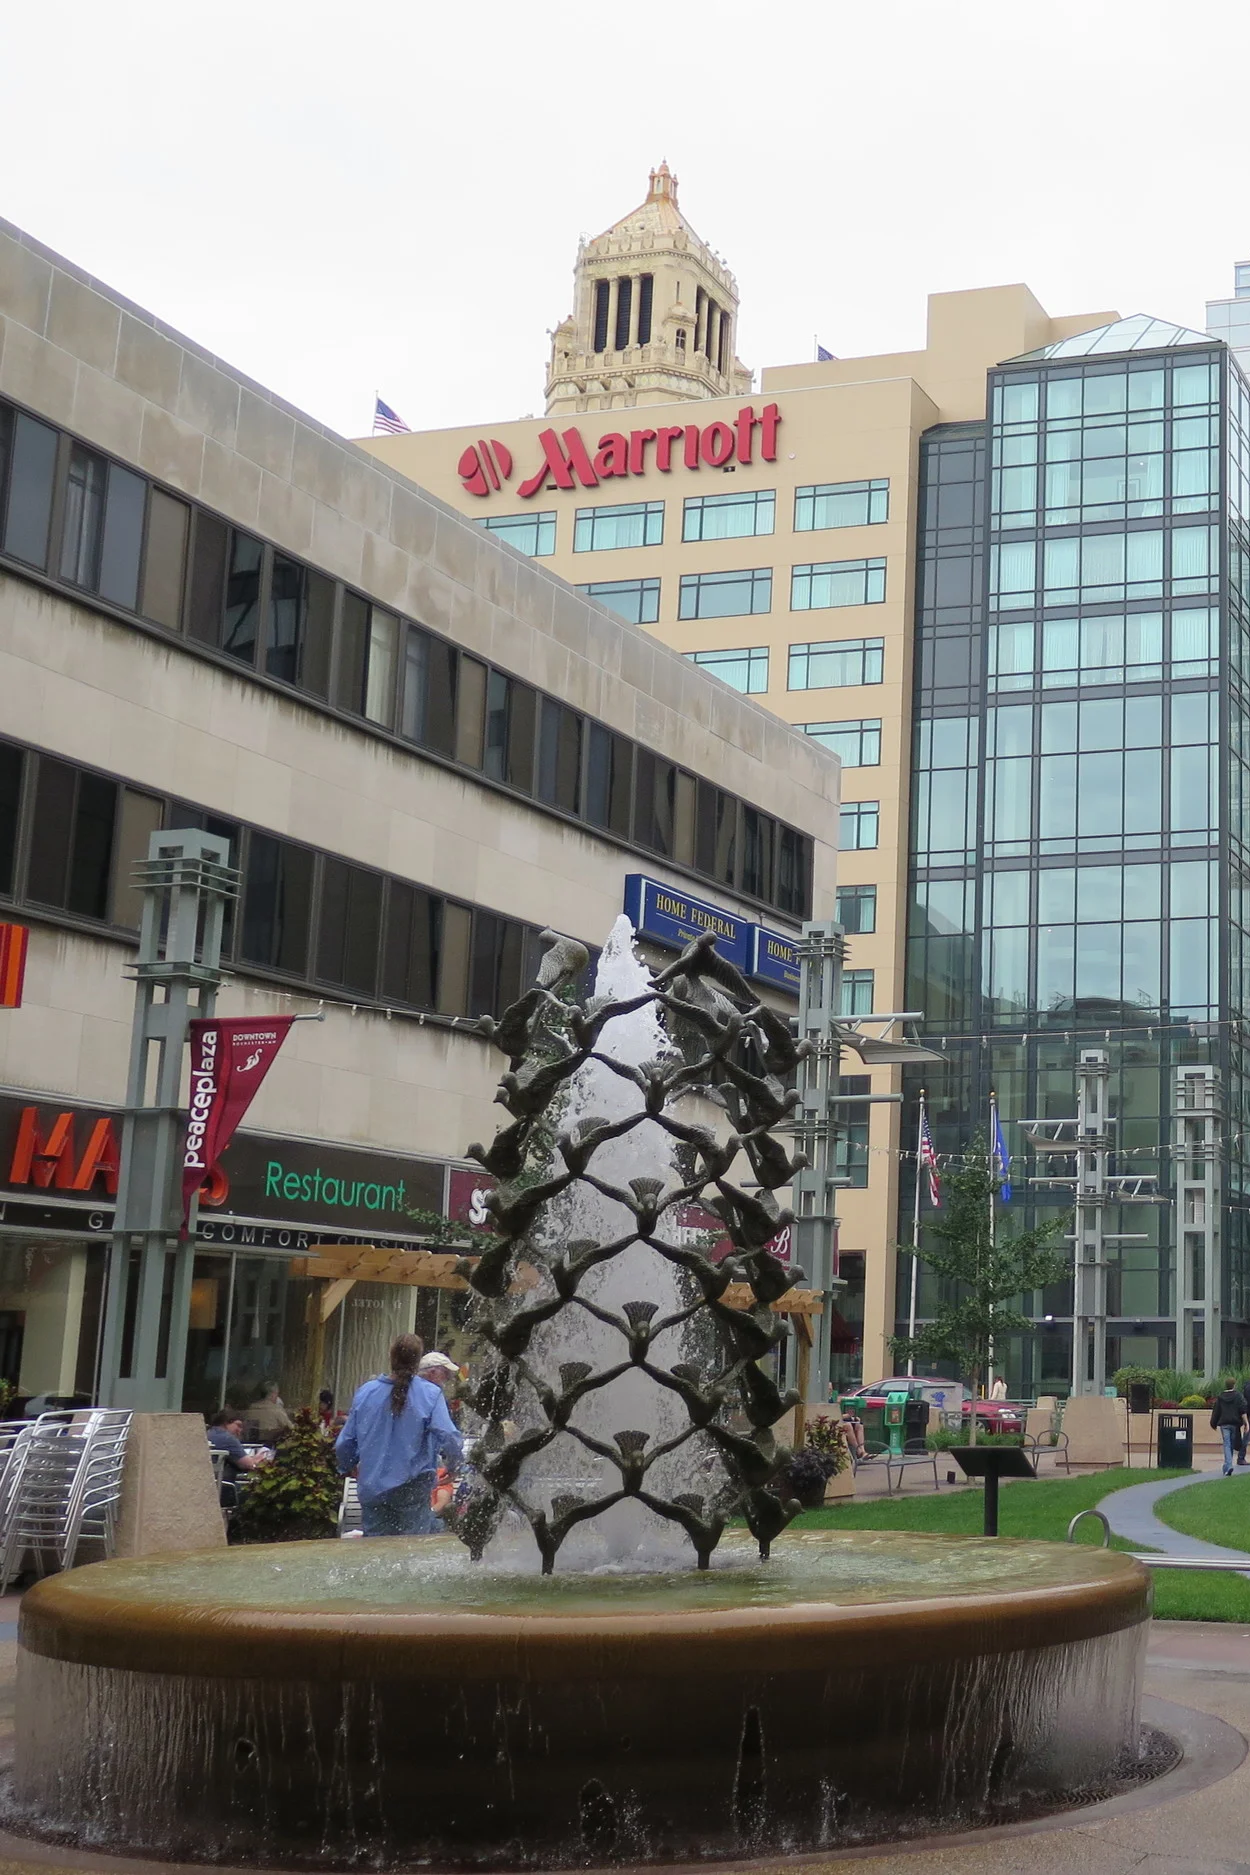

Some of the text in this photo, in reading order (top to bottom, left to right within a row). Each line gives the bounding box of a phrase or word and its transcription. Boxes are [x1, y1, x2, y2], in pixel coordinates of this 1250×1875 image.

[516, 402, 782, 498] Marriott
[656, 893, 737, 939] HOME FEDERAL
[767, 940, 793, 963] HOME
[232, 1032, 277, 1042] DOWNTOWN
[183, 1031, 218, 1169] peaceplaza
[265, 1161, 406, 1212] Restaurant
[202, 1222, 323, 1249] COMFORT
